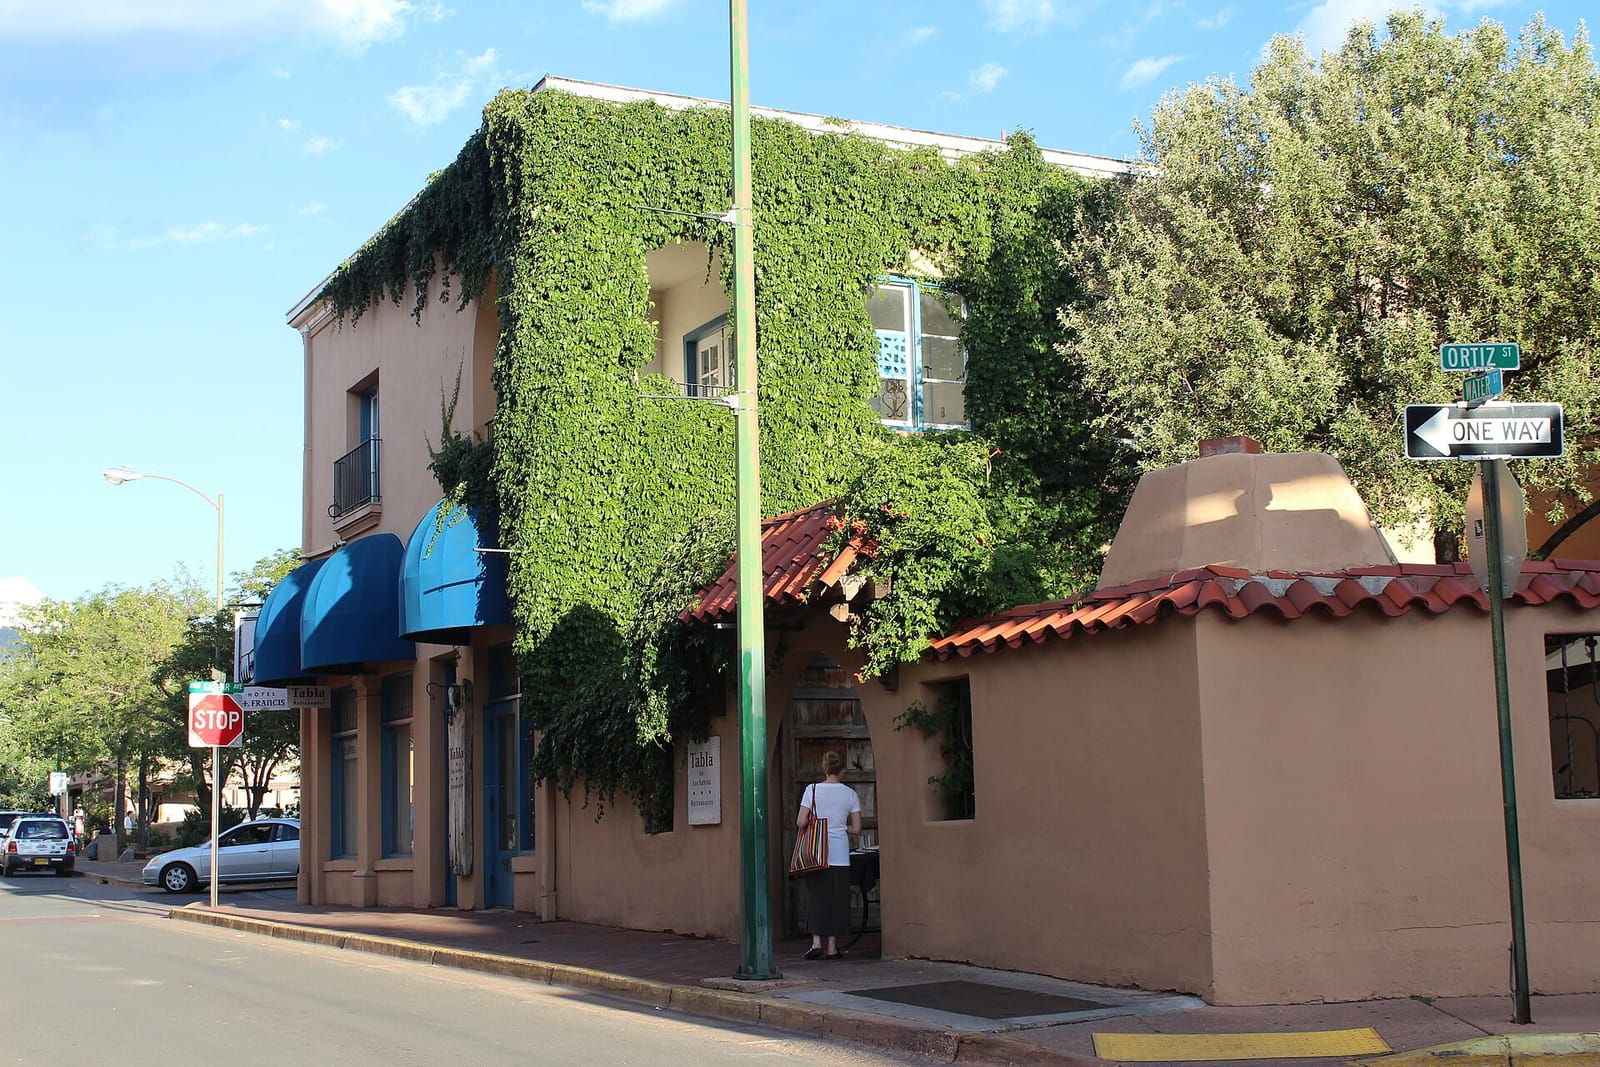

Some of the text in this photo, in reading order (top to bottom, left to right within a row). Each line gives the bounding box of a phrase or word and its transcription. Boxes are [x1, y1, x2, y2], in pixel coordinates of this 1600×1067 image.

[1447, 346, 1512, 367] ORTIZ ST
[1465, 373, 1498, 401] WATER ST
[1453, 421, 1544, 441] ONE WAY
[251, 698, 285, 707] FRANCIS
[291, 687, 325, 698] Tabla
[194, 710, 240, 730] STOP
[690, 751, 713, 768] Tabla
